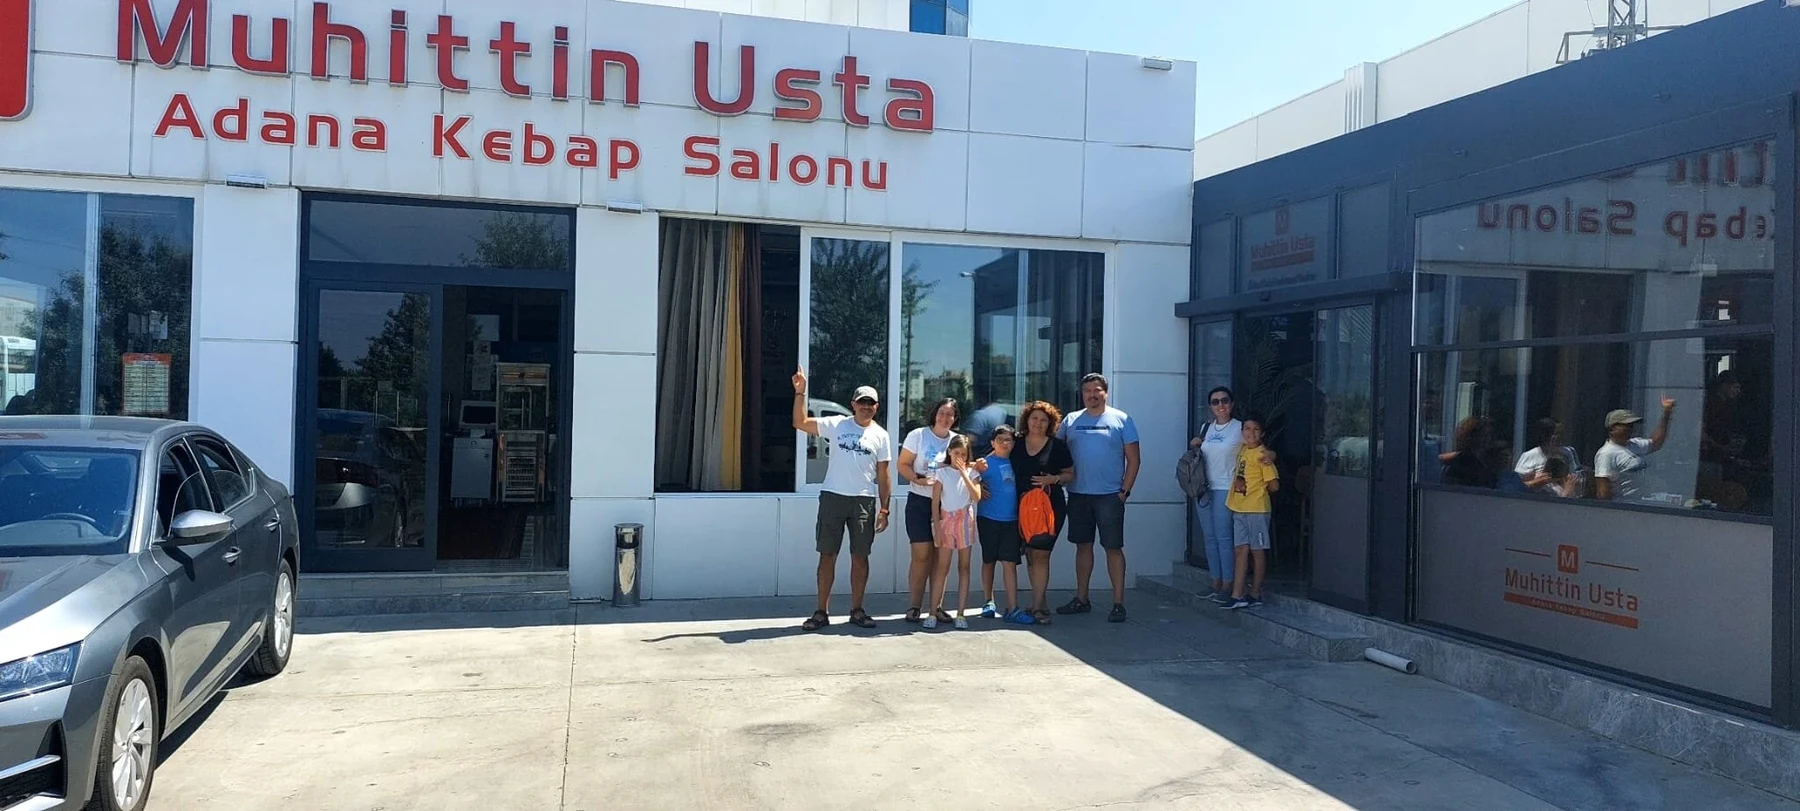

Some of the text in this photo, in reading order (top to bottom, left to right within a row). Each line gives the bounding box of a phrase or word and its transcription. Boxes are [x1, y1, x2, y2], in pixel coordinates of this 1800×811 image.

[117, 0, 935, 132] Muhittin Usta
[154, 92, 888, 192] Adana Kebap Salonu
[1504, 567, 1638, 612] Muhittin Usta
[1560, 550, 1576, 569] M
